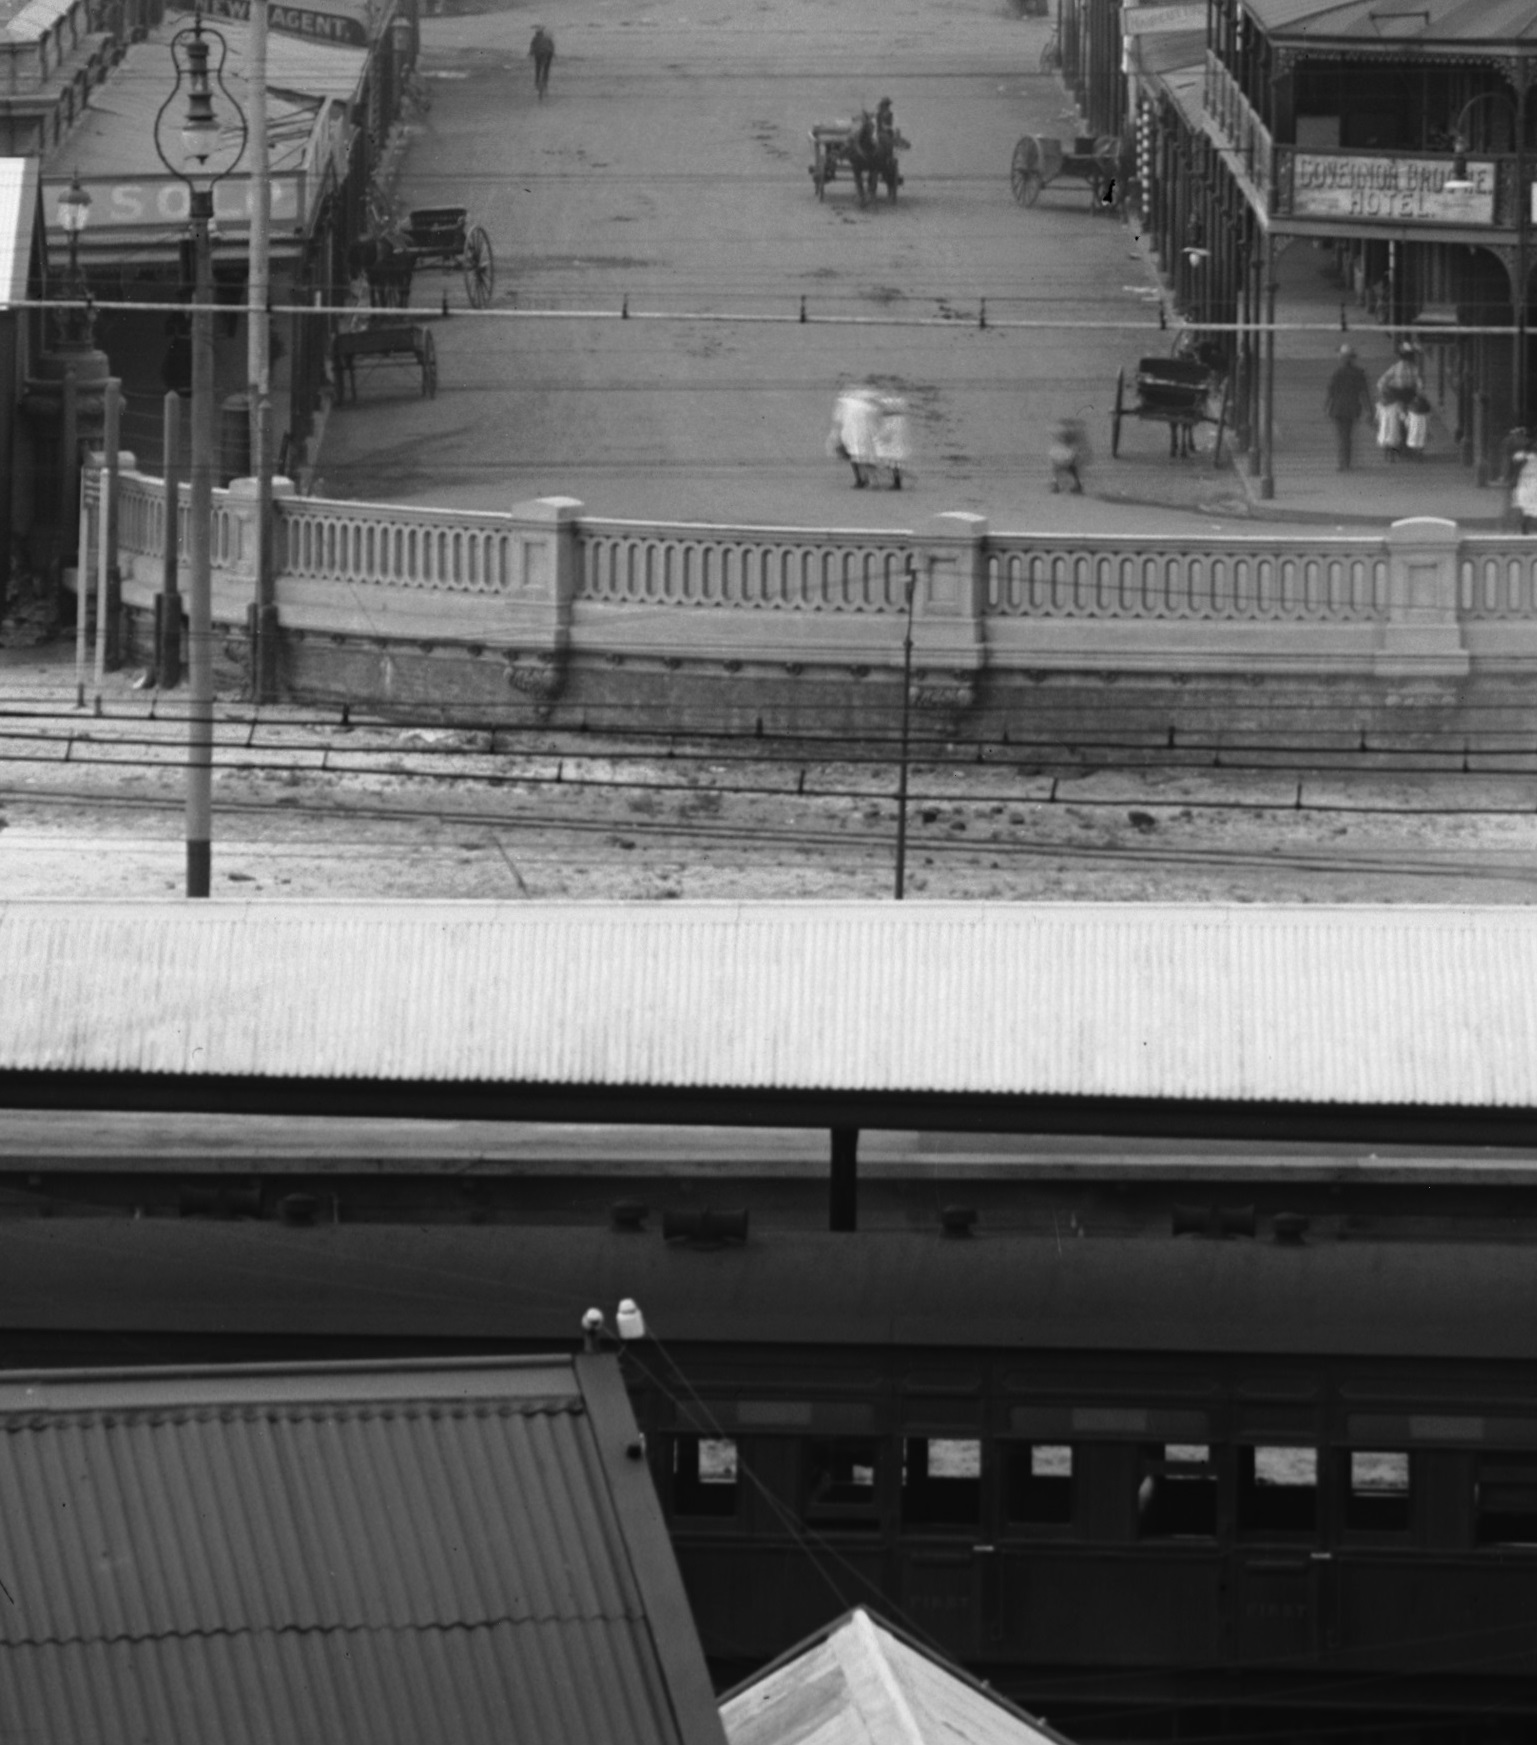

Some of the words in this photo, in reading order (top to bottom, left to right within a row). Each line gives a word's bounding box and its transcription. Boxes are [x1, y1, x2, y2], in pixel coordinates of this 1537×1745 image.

[269, 6, 351, 38] AGENT.
[1299, 158, 1399, 192] GOVERNOR
[908, 1594, 970, 1610] FIRST
[1246, 1602, 1308, 1617] FIRST
